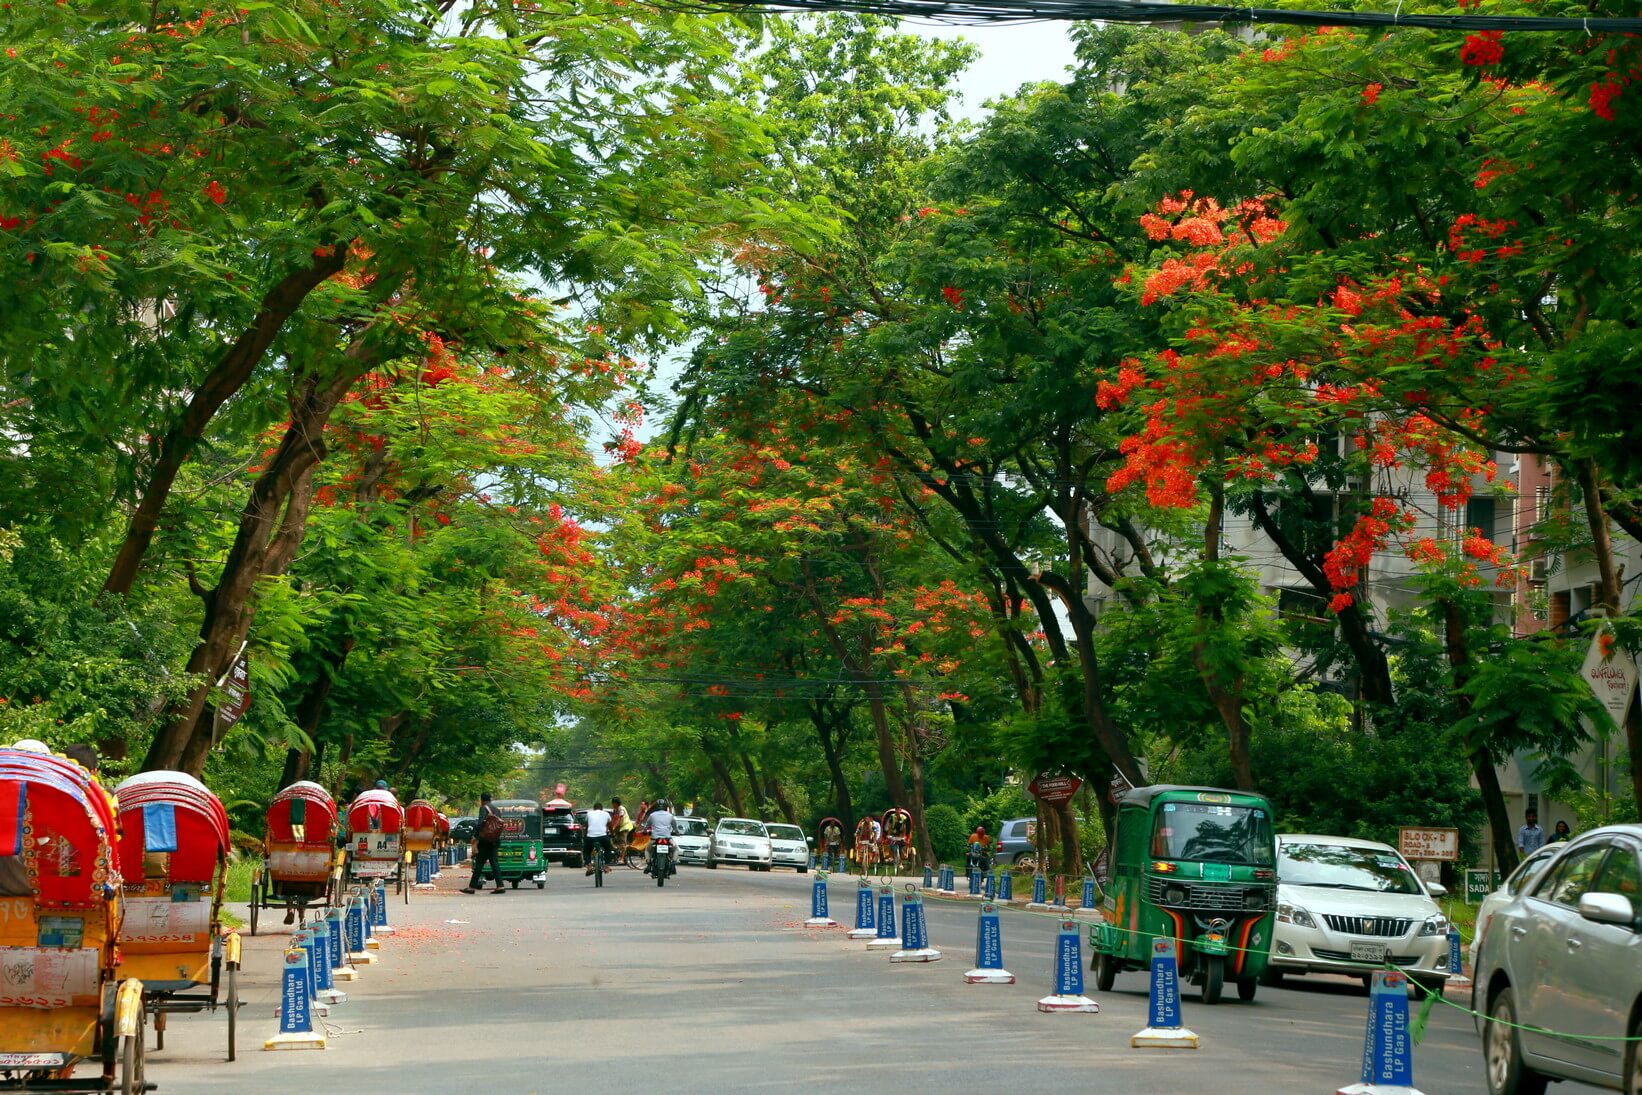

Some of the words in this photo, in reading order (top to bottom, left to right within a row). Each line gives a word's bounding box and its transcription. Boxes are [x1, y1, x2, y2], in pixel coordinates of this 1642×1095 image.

[991, 953, 997, 961] LP
[1063, 939, 1071, 991] Bashundhara
[1071, 977, 1078, 986] LP
[1166, 968, 1174, 985] Ltd.
[296, 978, 304, 994] Ltd.
[1155, 963, 1164, 1023] Bashundhara
[287, 973, 295, 1029] Bashundhara
[296, 996, 304, 1010] Gas
[1166, 988, 1174, 1004] Gas
[296, 1013, 304, 1023] LP
[1166, 1006, 1174, 1017] LP
[1394, 1009, 1404, 1031] Ltd.
[1382, 1002, 1394, 1079] Bashundhara
[1394, 1034, 1404, 1055] Gas
[1394, 1059, 1404, 1072] LP
